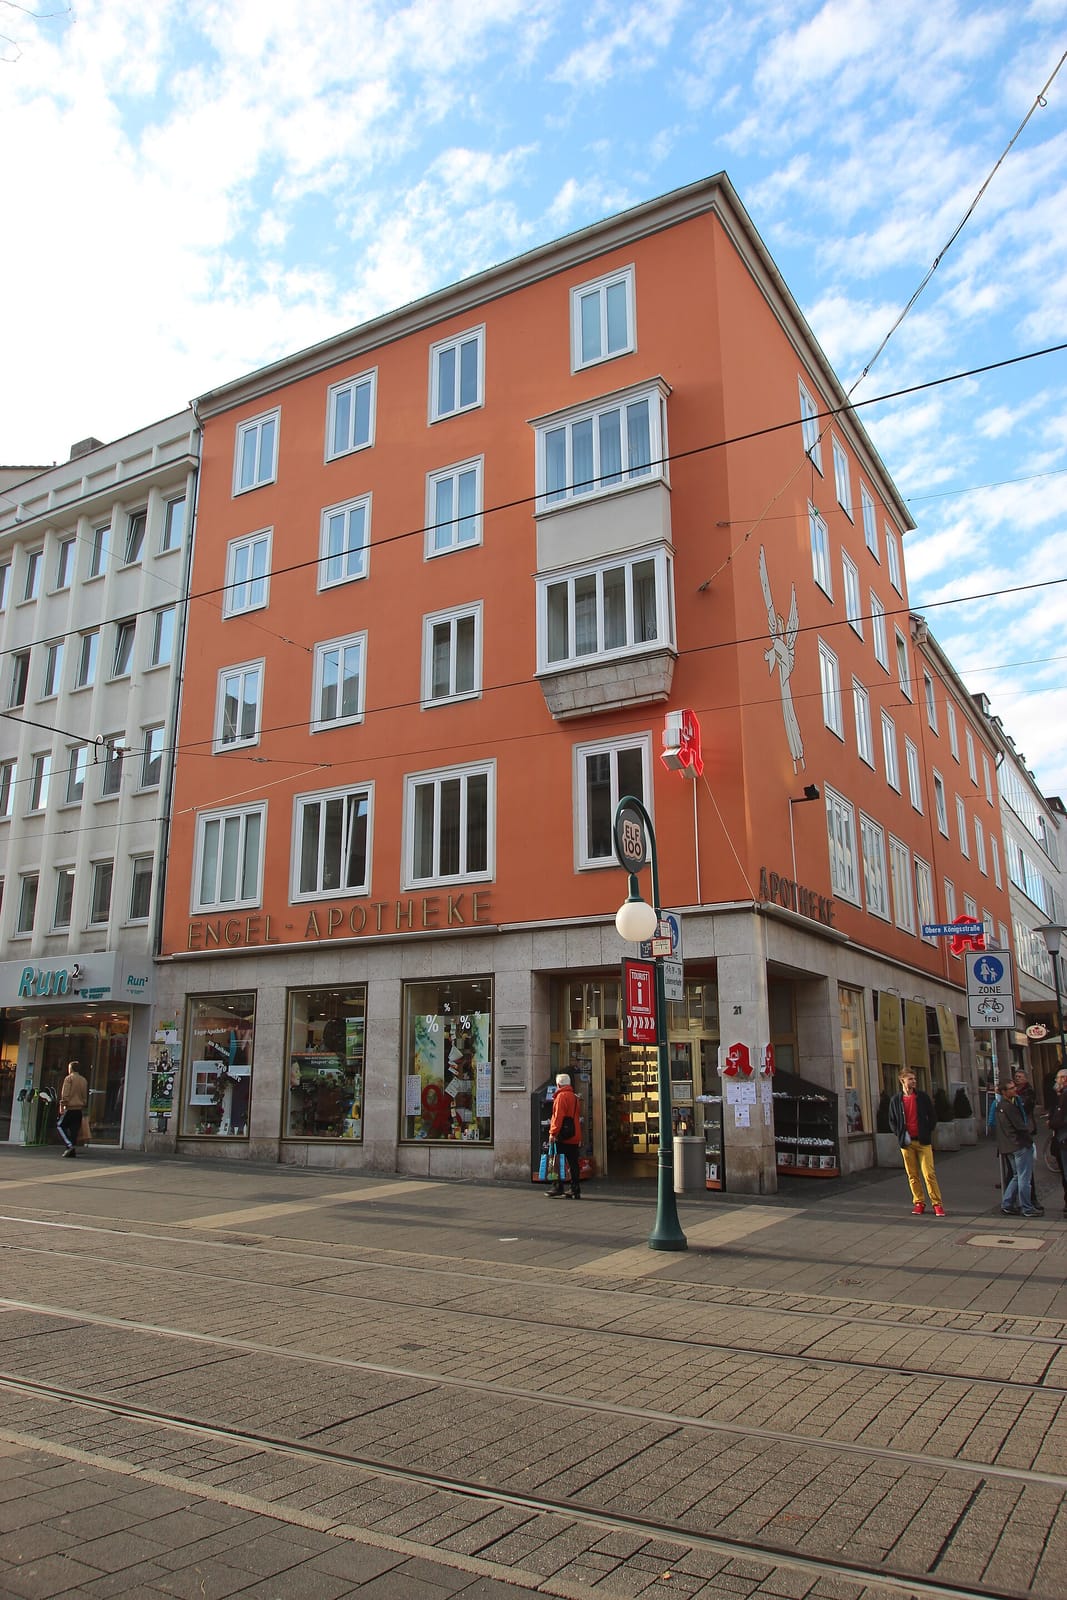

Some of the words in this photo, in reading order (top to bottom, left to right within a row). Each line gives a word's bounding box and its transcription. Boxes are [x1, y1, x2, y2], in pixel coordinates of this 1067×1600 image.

[625, 824, 640, 841] ELF
[624, 838, 642, 856] 100
[759, 866, 836, 926] APOTHEKE
[187, 915, 279, 949] ENGEL
[304, 890, 492, 938] APOTHEKE
[924, 926, 941, 934] Obere
[978, 986, 1001, 994] ZONE
[733, 1005, 742, 1016] 21
[984, 1015, 999, 1023] frei
